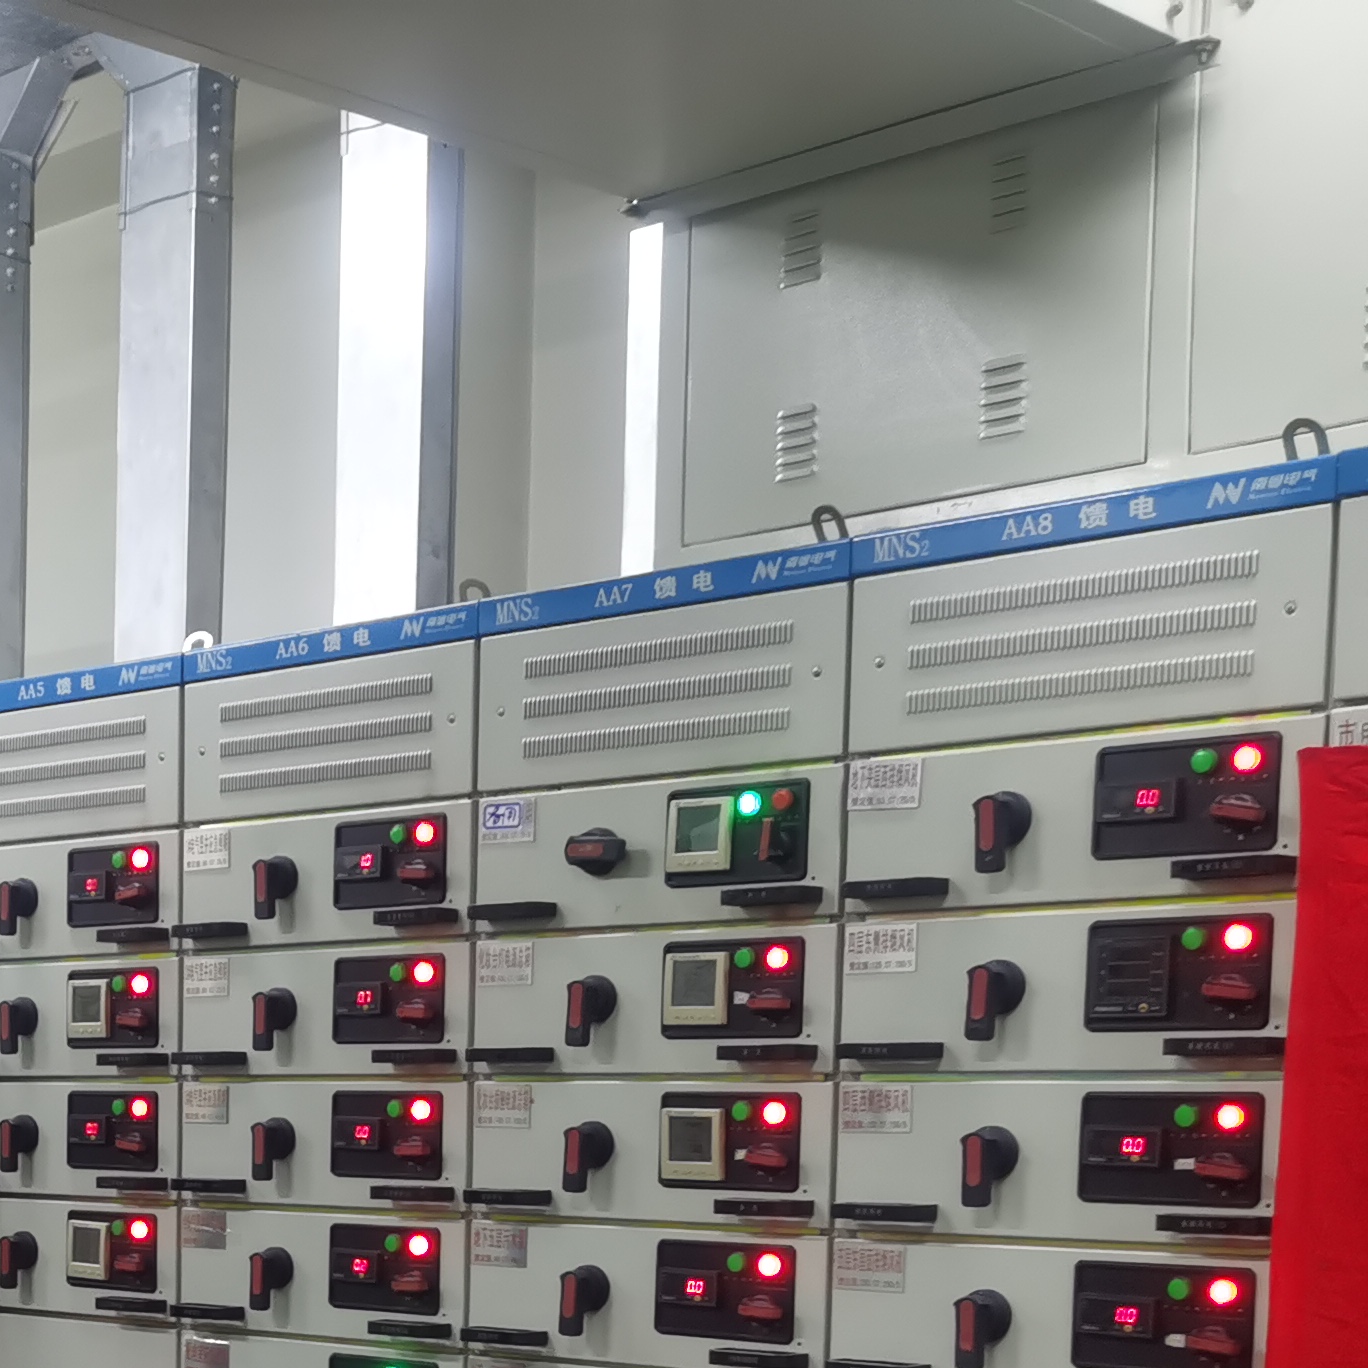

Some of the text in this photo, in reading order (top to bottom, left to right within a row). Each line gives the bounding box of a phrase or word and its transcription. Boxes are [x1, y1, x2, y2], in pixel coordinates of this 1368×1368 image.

[1001, 512, 1053, 542] AA8
[594, 582, 634, 609] AA7
[275, 637, 310, 660] AA6
[18, 681, 45, 701] AA5
[1121, 1136, 1146, 1154] 0.0
